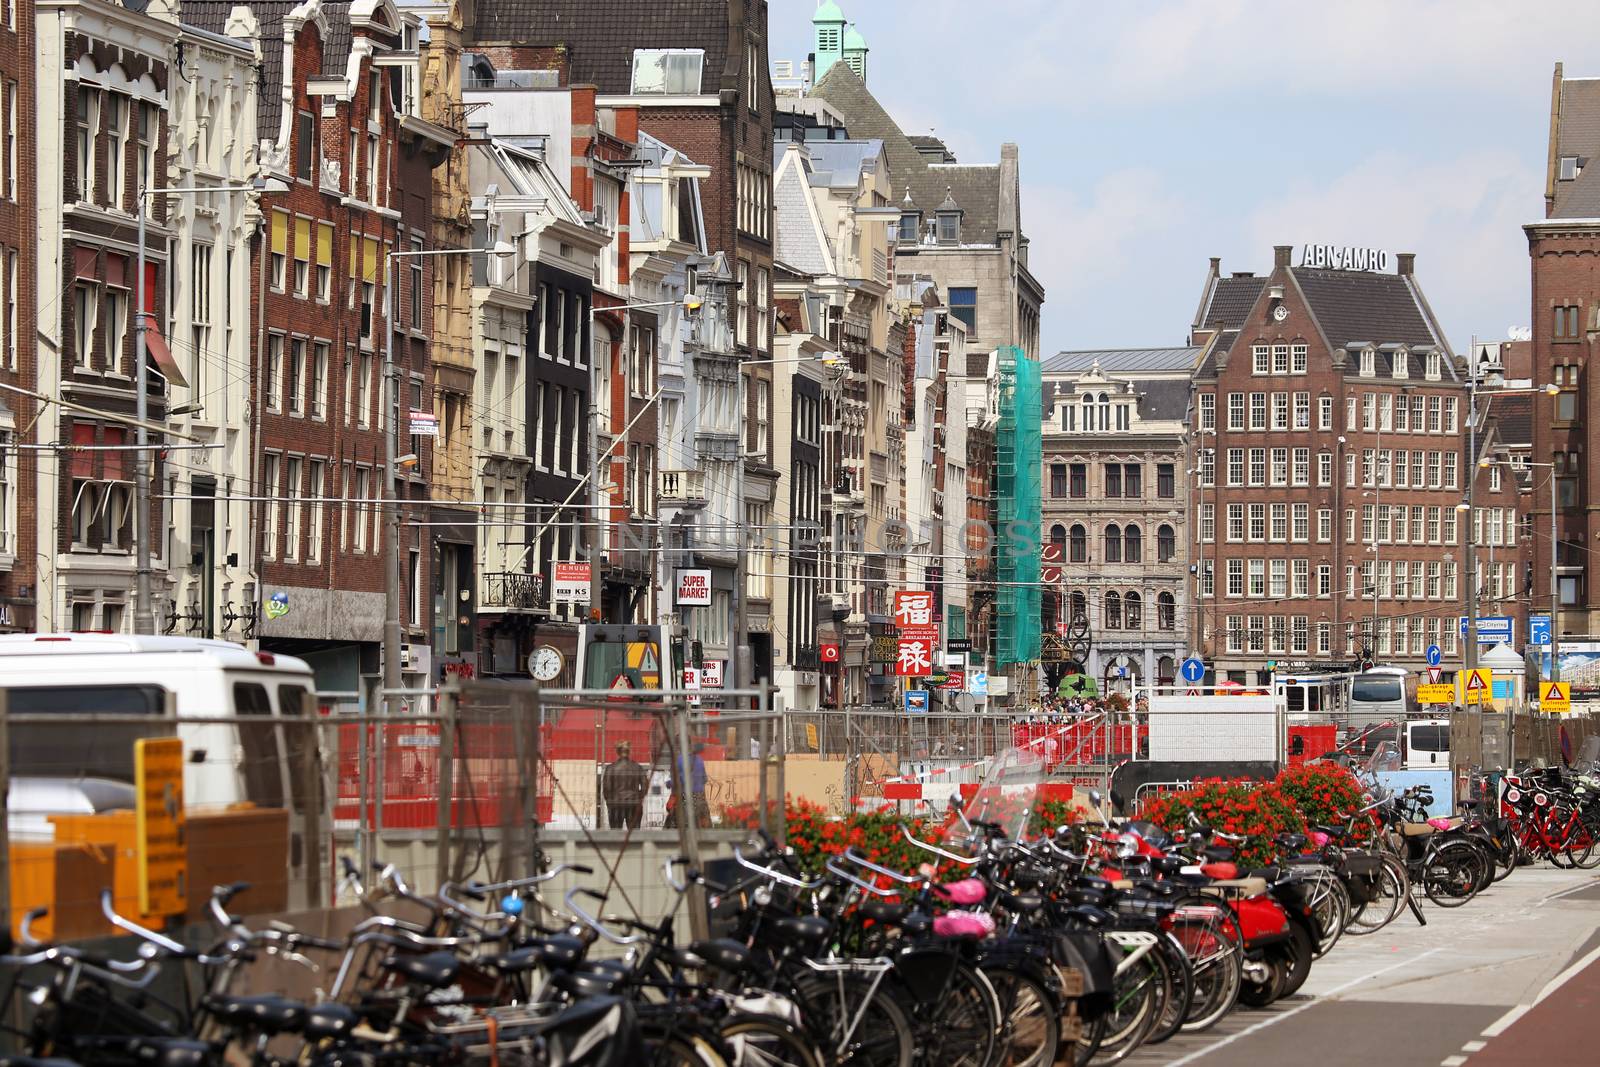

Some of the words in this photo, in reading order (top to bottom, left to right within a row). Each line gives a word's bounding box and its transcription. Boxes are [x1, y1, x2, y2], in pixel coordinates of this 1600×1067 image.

[682, 575, 706, 587] SUPER
[679, 587, 709, 599] MARKET
[896, 595, 931, 625] 福
